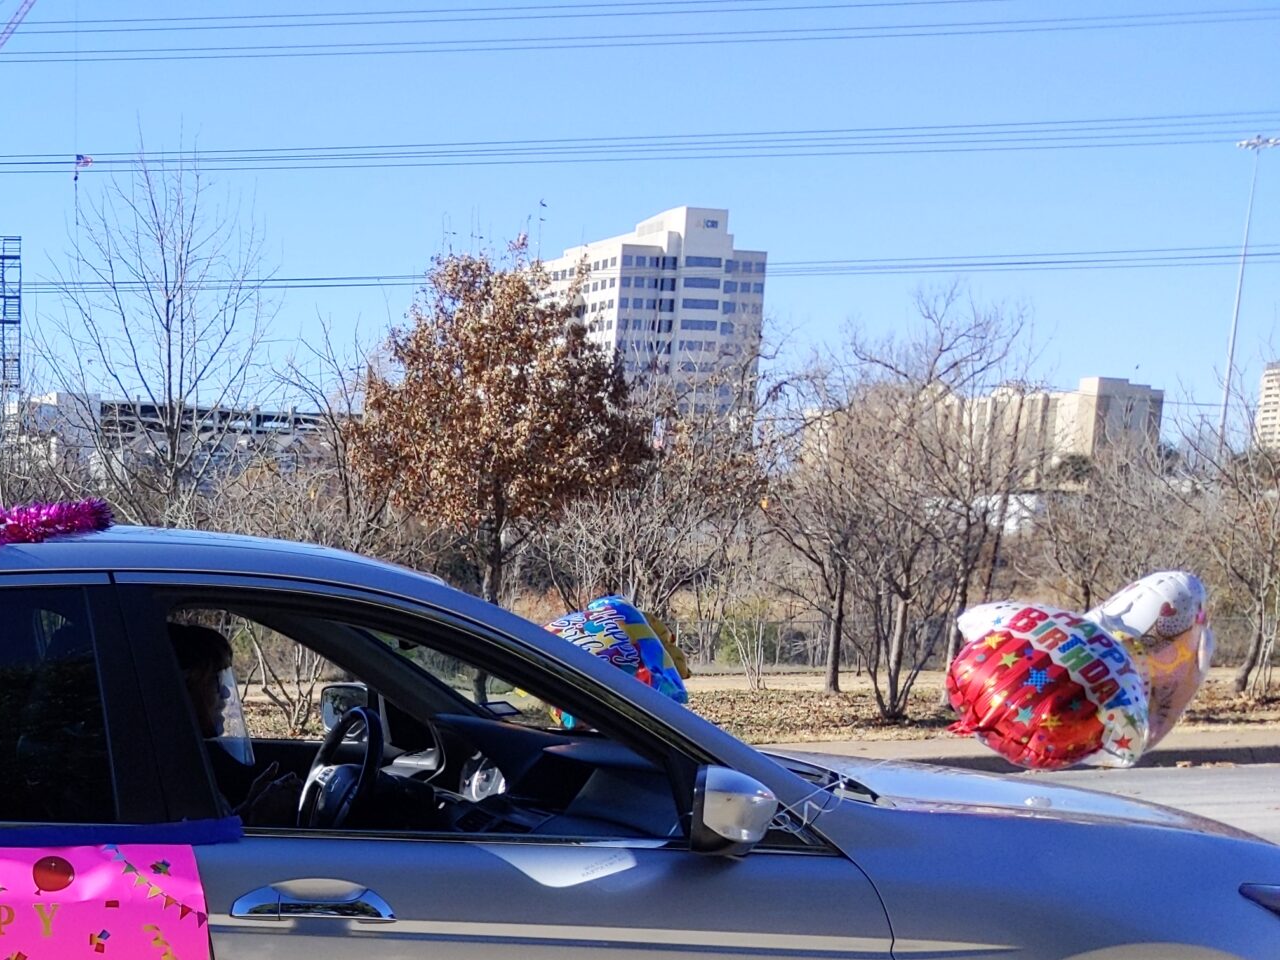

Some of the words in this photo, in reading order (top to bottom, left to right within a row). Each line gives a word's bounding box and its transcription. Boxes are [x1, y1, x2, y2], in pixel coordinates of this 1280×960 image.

[589, 609, 640, 667] Happy
[1007, 606, 1132, 710] BIRTHDAY
[1052, 611, 1137, 677] HAPPY
